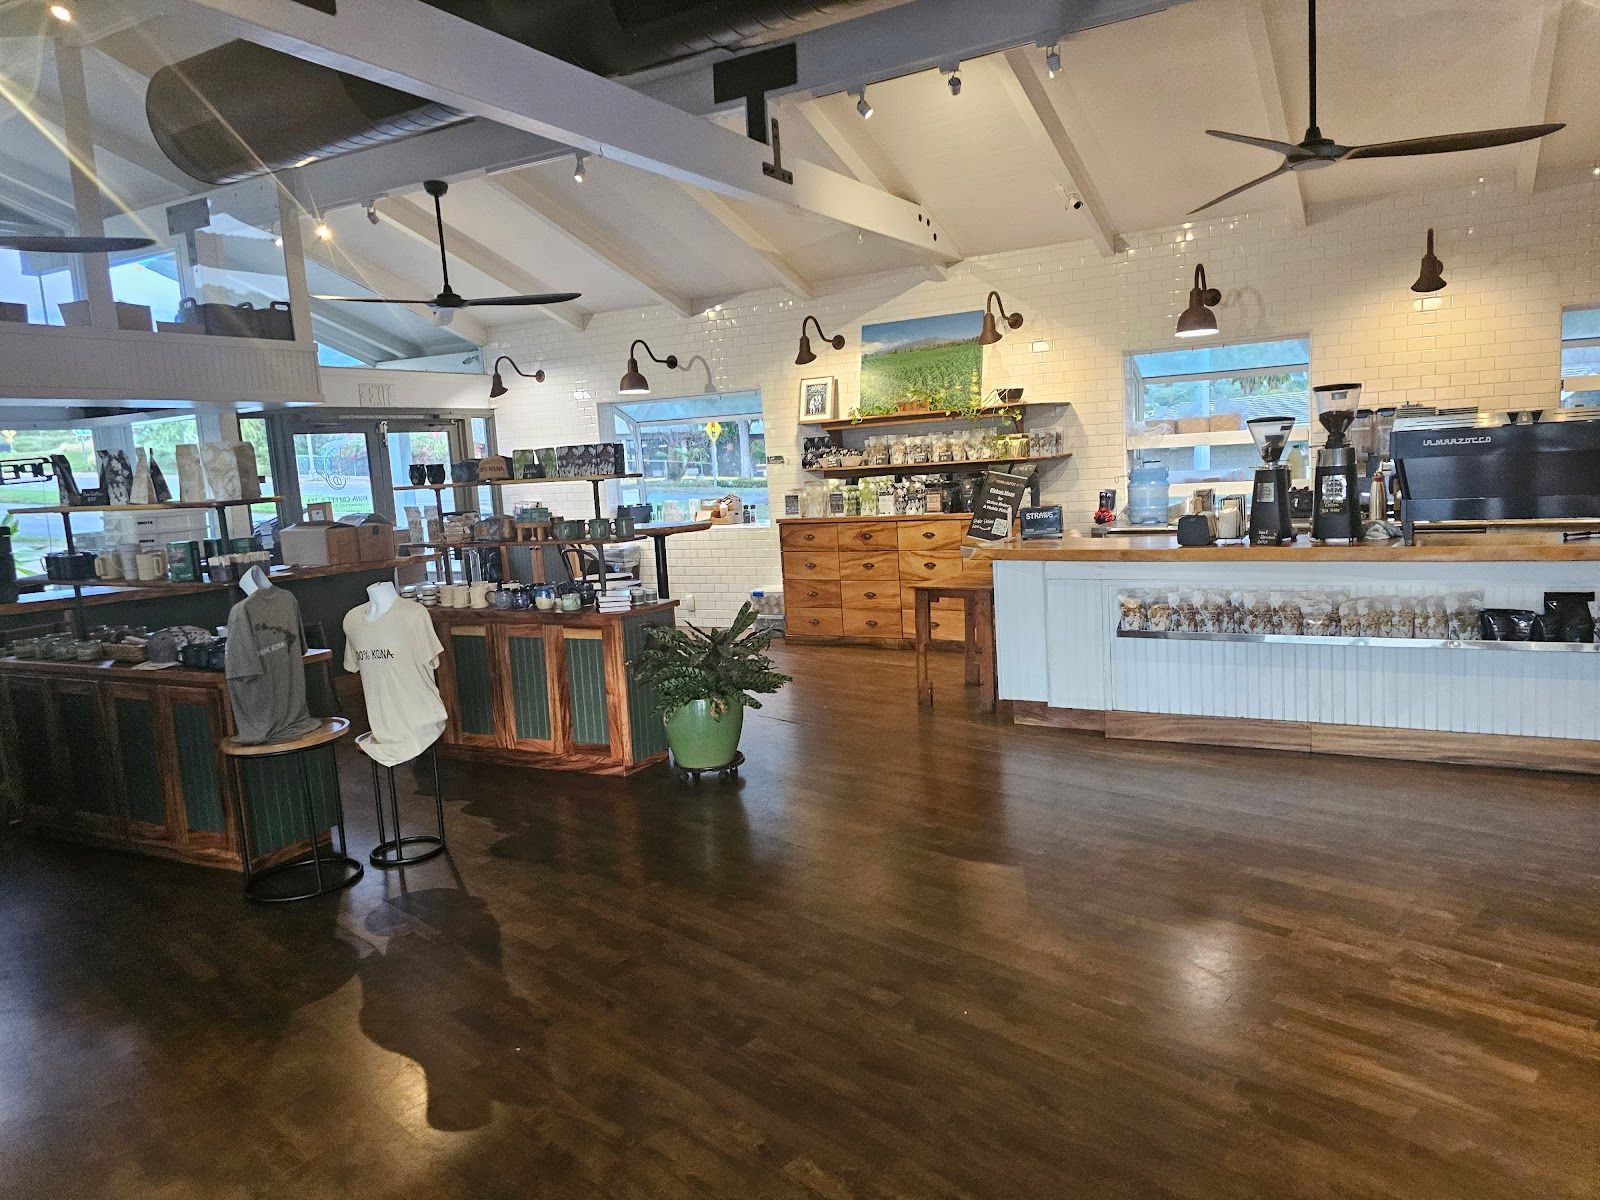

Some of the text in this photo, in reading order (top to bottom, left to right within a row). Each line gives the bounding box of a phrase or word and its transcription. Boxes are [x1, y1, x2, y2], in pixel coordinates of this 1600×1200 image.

[1435, 436, 1492, 446] MARZOCCO
[1025, 511, 1054, 520] STRAWS
[371, 649, 395, 660] KONA
